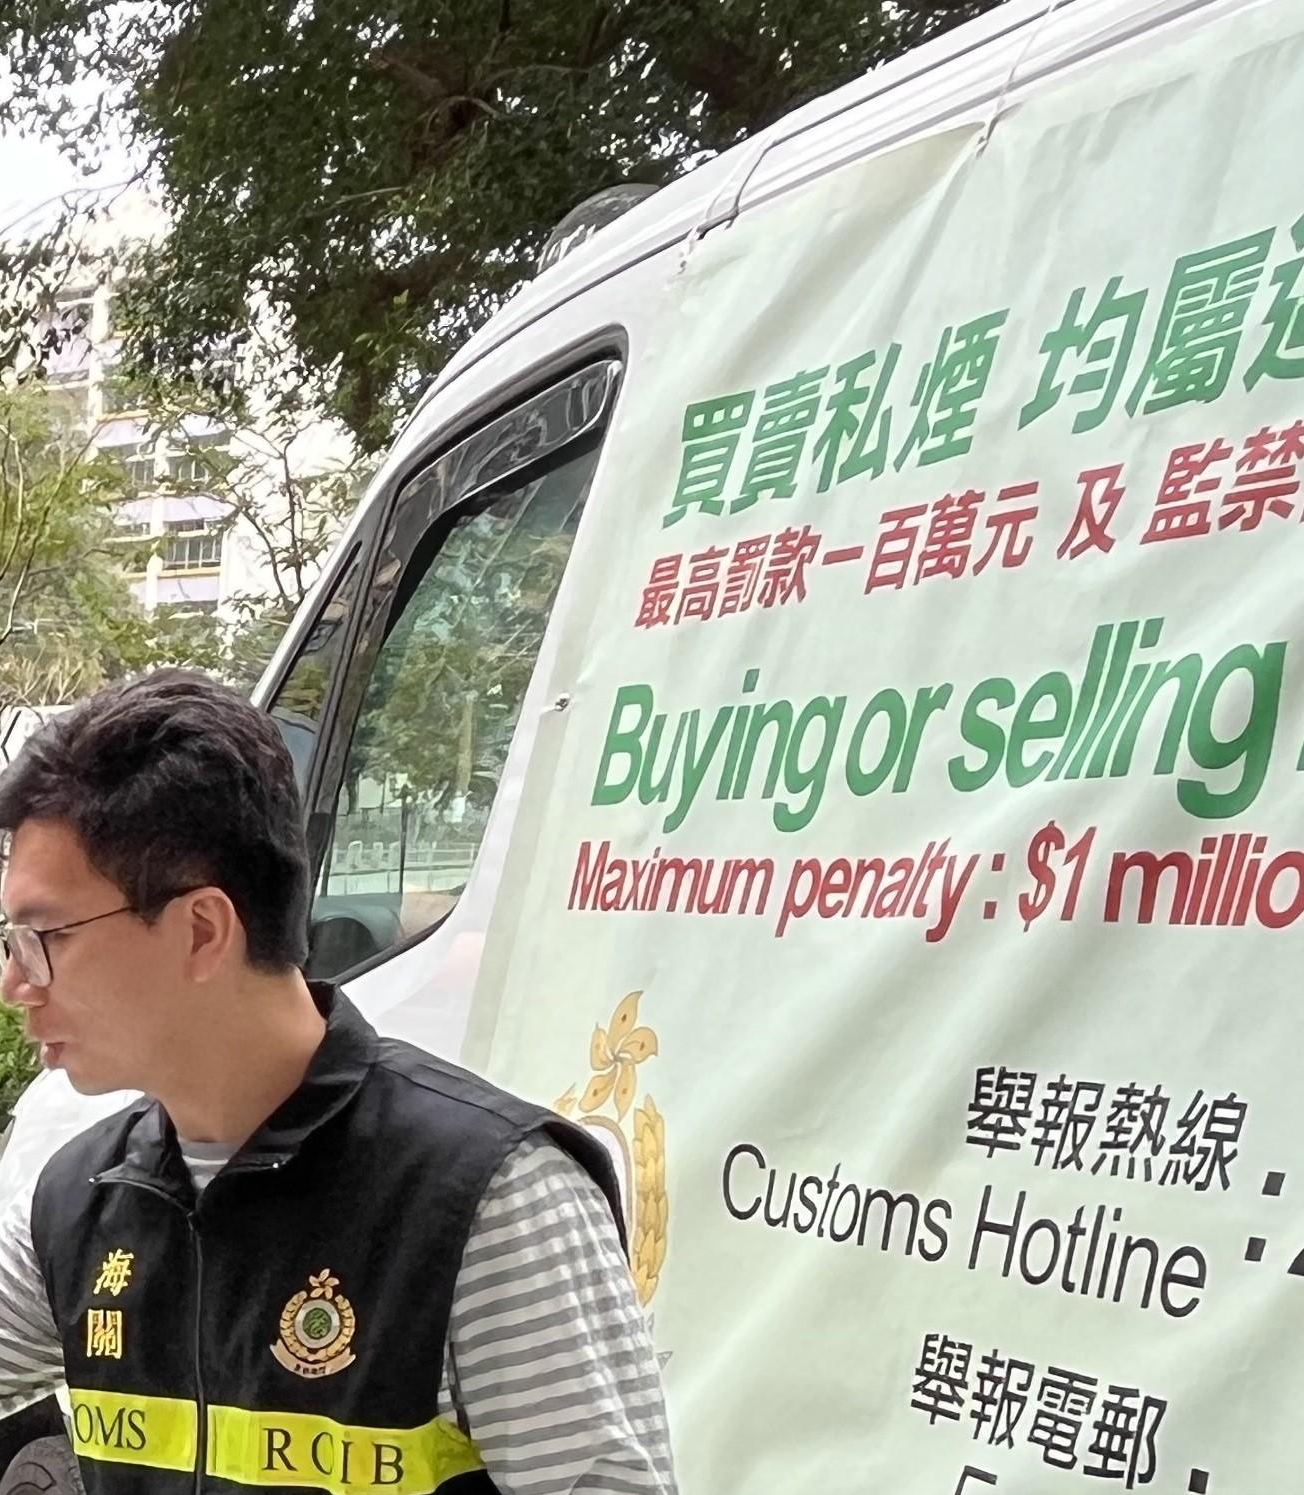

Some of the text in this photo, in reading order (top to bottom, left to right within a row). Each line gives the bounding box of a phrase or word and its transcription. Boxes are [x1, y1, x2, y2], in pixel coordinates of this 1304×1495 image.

[661, 308, 1011, 530] 買賣私煙
[634, 419, 1304, 631] 最高罰款一百萬元 及 監禁
[591, 616, 1288, 834] Buying or selling
[567, 840, 777, 920] Maximum
[1018, 819, 1099, 934] $1
[964, 1066, 1250, 1194] 舉報熱線
[87, 1248, 134, 1359] 海關
[721, 1143, 1208, 1320] Customs Hotline
[910, 1334, 1169, 1493] 舉報電郵
